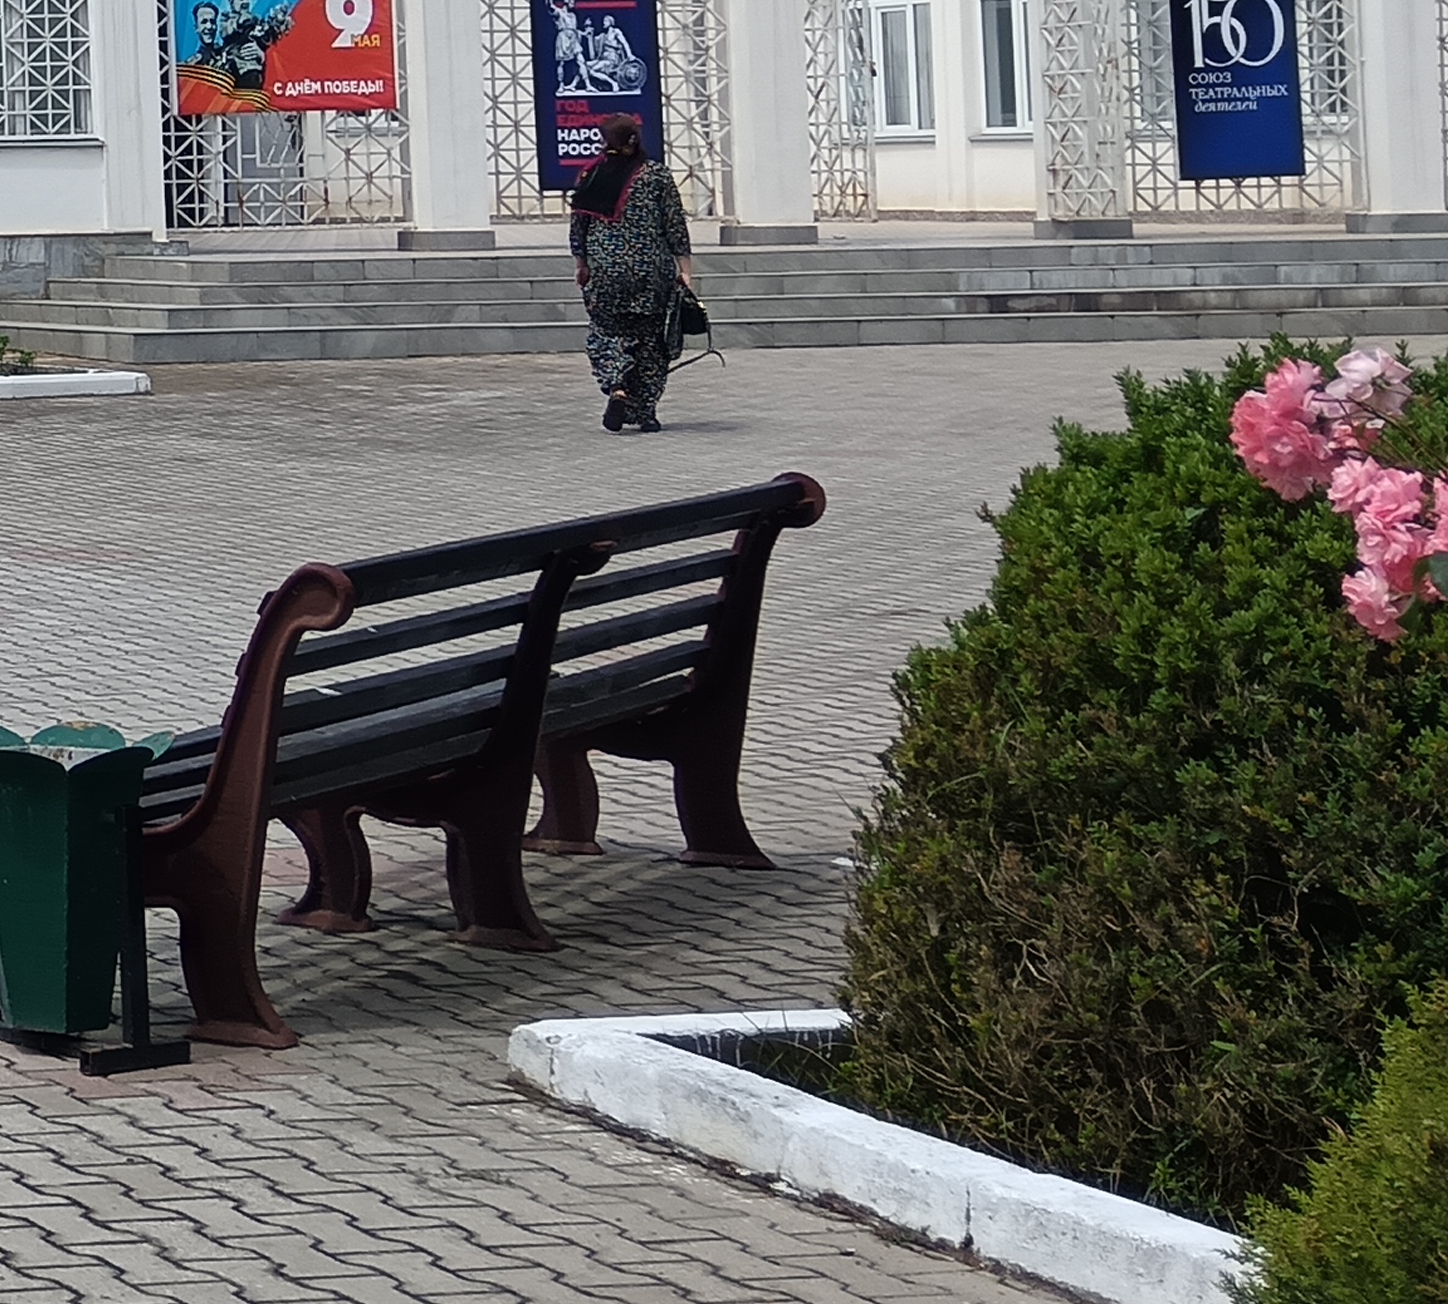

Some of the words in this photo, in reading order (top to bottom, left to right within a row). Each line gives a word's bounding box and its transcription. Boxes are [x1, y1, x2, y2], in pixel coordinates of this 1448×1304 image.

[351, 33, 382, 48] МАЯ
[1188, 72, 1232, 84] СОЮЗ
[273, 82, 283, 95] С
[285, 78, 322, 97] ДНЁМ
[323, 79, 385, 95] ПОБЕДЫ!
[1188, 84, 1289, 100] ТЕАТРАЛЬНЫХ
[556, 99, 590, 114] ГОД
[556, 113, 644, 128] ЕДИНА
[557, 127, 602, 142] НАРО
[557, 143, 604, 156] РОСС
